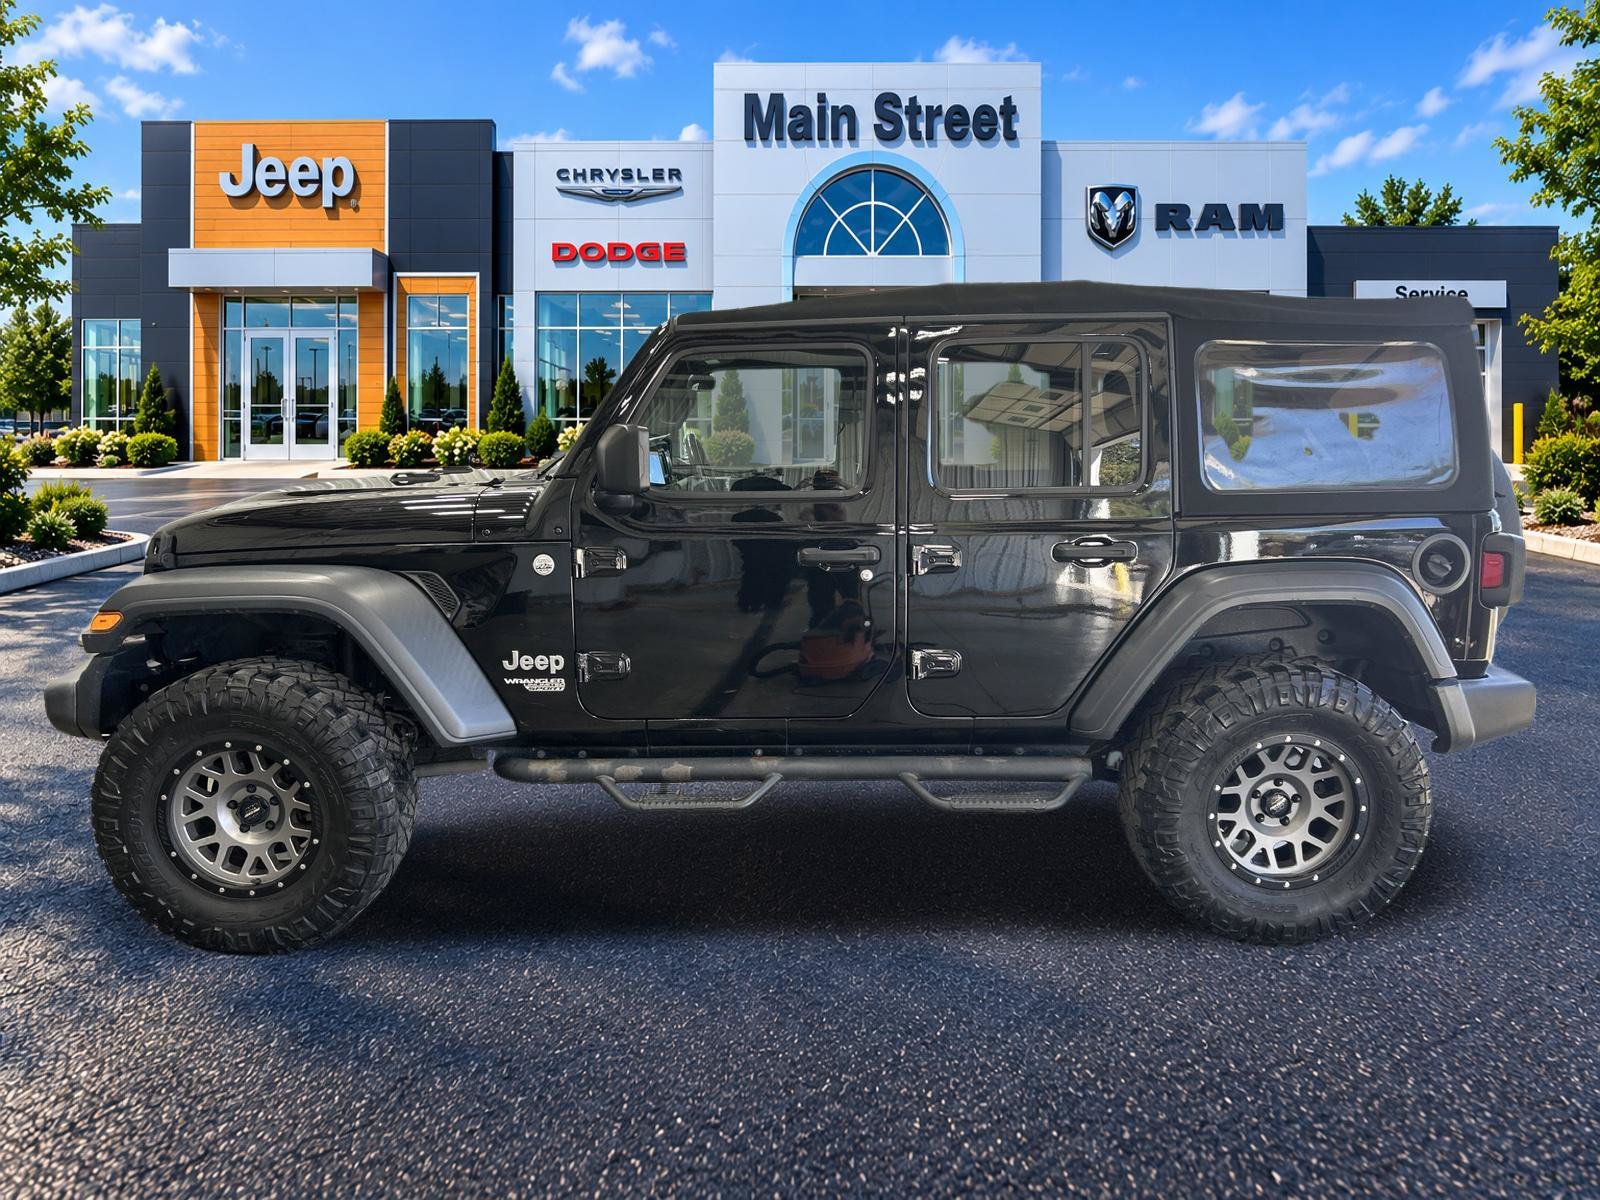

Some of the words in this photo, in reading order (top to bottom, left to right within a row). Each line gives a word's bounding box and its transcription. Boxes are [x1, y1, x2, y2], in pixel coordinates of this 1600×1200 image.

[744, 92, 857, 141] Main
[873, 91, 1018, 141] Street
[218, 143, 355, 208] Jeep
[556, 168, 682, 182] CHRYSLER
[1155, 203, 1284, 231] RAM
[551, 242, 687, 262] DODGE
[502, 650, 565, 674] Jeep
